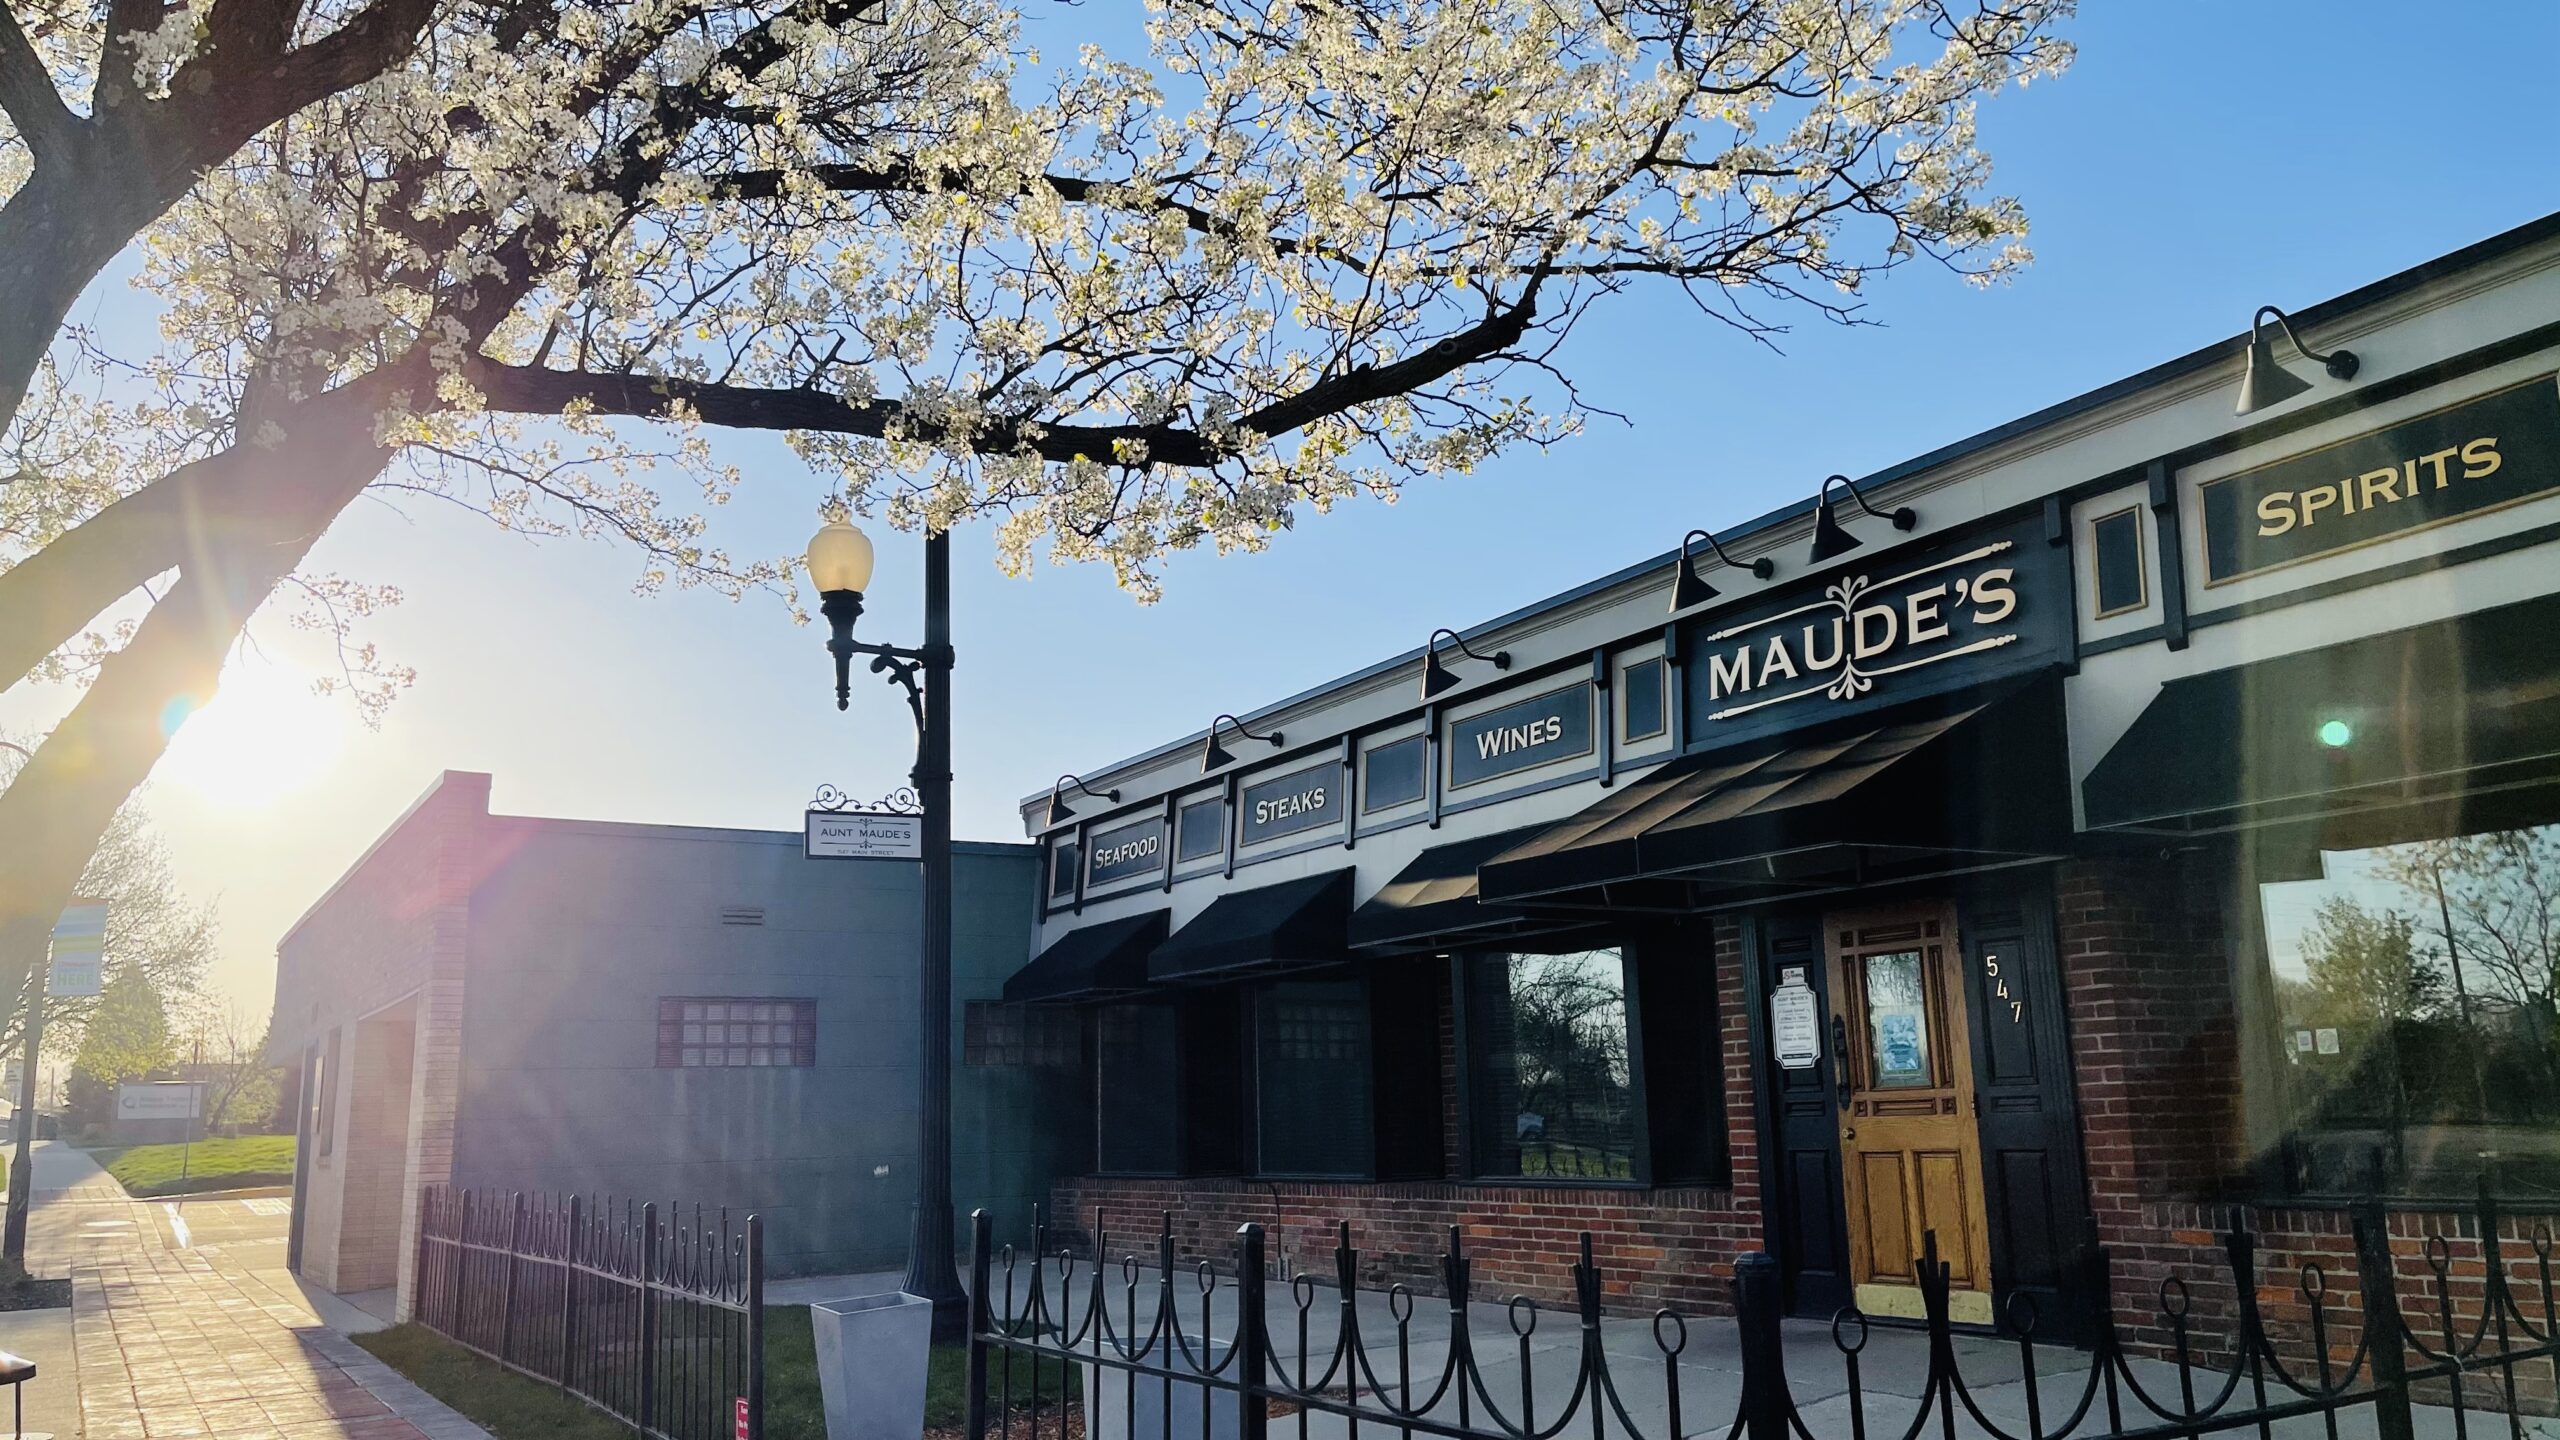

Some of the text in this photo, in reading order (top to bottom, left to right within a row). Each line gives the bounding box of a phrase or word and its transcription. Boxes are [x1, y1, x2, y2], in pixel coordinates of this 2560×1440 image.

[2257, 437, 2502, 537] SPIRITS
[1709, 568, 2017, 701] MAUDE'S
[1476, 716, 1562, 760] WINES
[1255, 787, 1325, 825] STEAKS
[820, 828, 853, 837] AUNT
[1095, 836, 1158, 869] SEAFOOD
[57, 974, 94, 986] HERE
